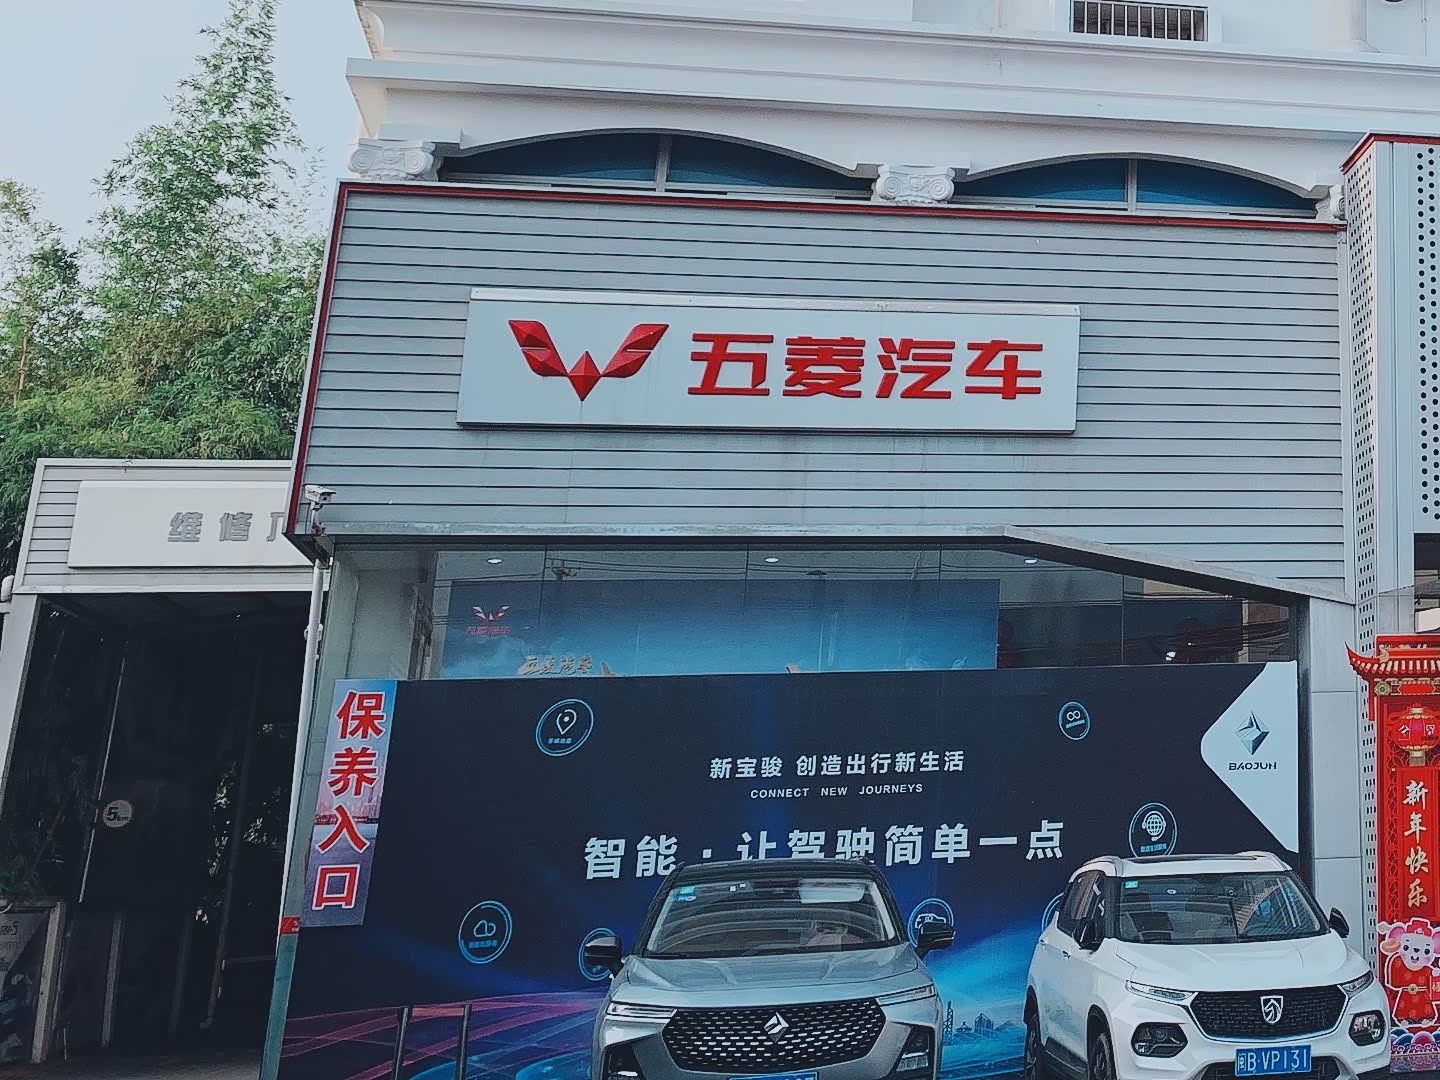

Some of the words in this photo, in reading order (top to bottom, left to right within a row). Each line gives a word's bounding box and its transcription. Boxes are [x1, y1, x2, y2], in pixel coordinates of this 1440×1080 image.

[687, 332, 1043, 400] 五菱汽车
[709, 757, 783, 779] 新宝骏
[796, 751, 965, 777] 创造出行新生活
[1229, 761, 1277, 771] BAOJUN
[312, 690, 386, 910] 保养入口
[750, 788, 810, 799] CONNECT
[820, 786, 848, 796] NEW
[858, 783, 923, 795] JOURNEYS
[1403, 780, 1429, 908] 新年快乐
